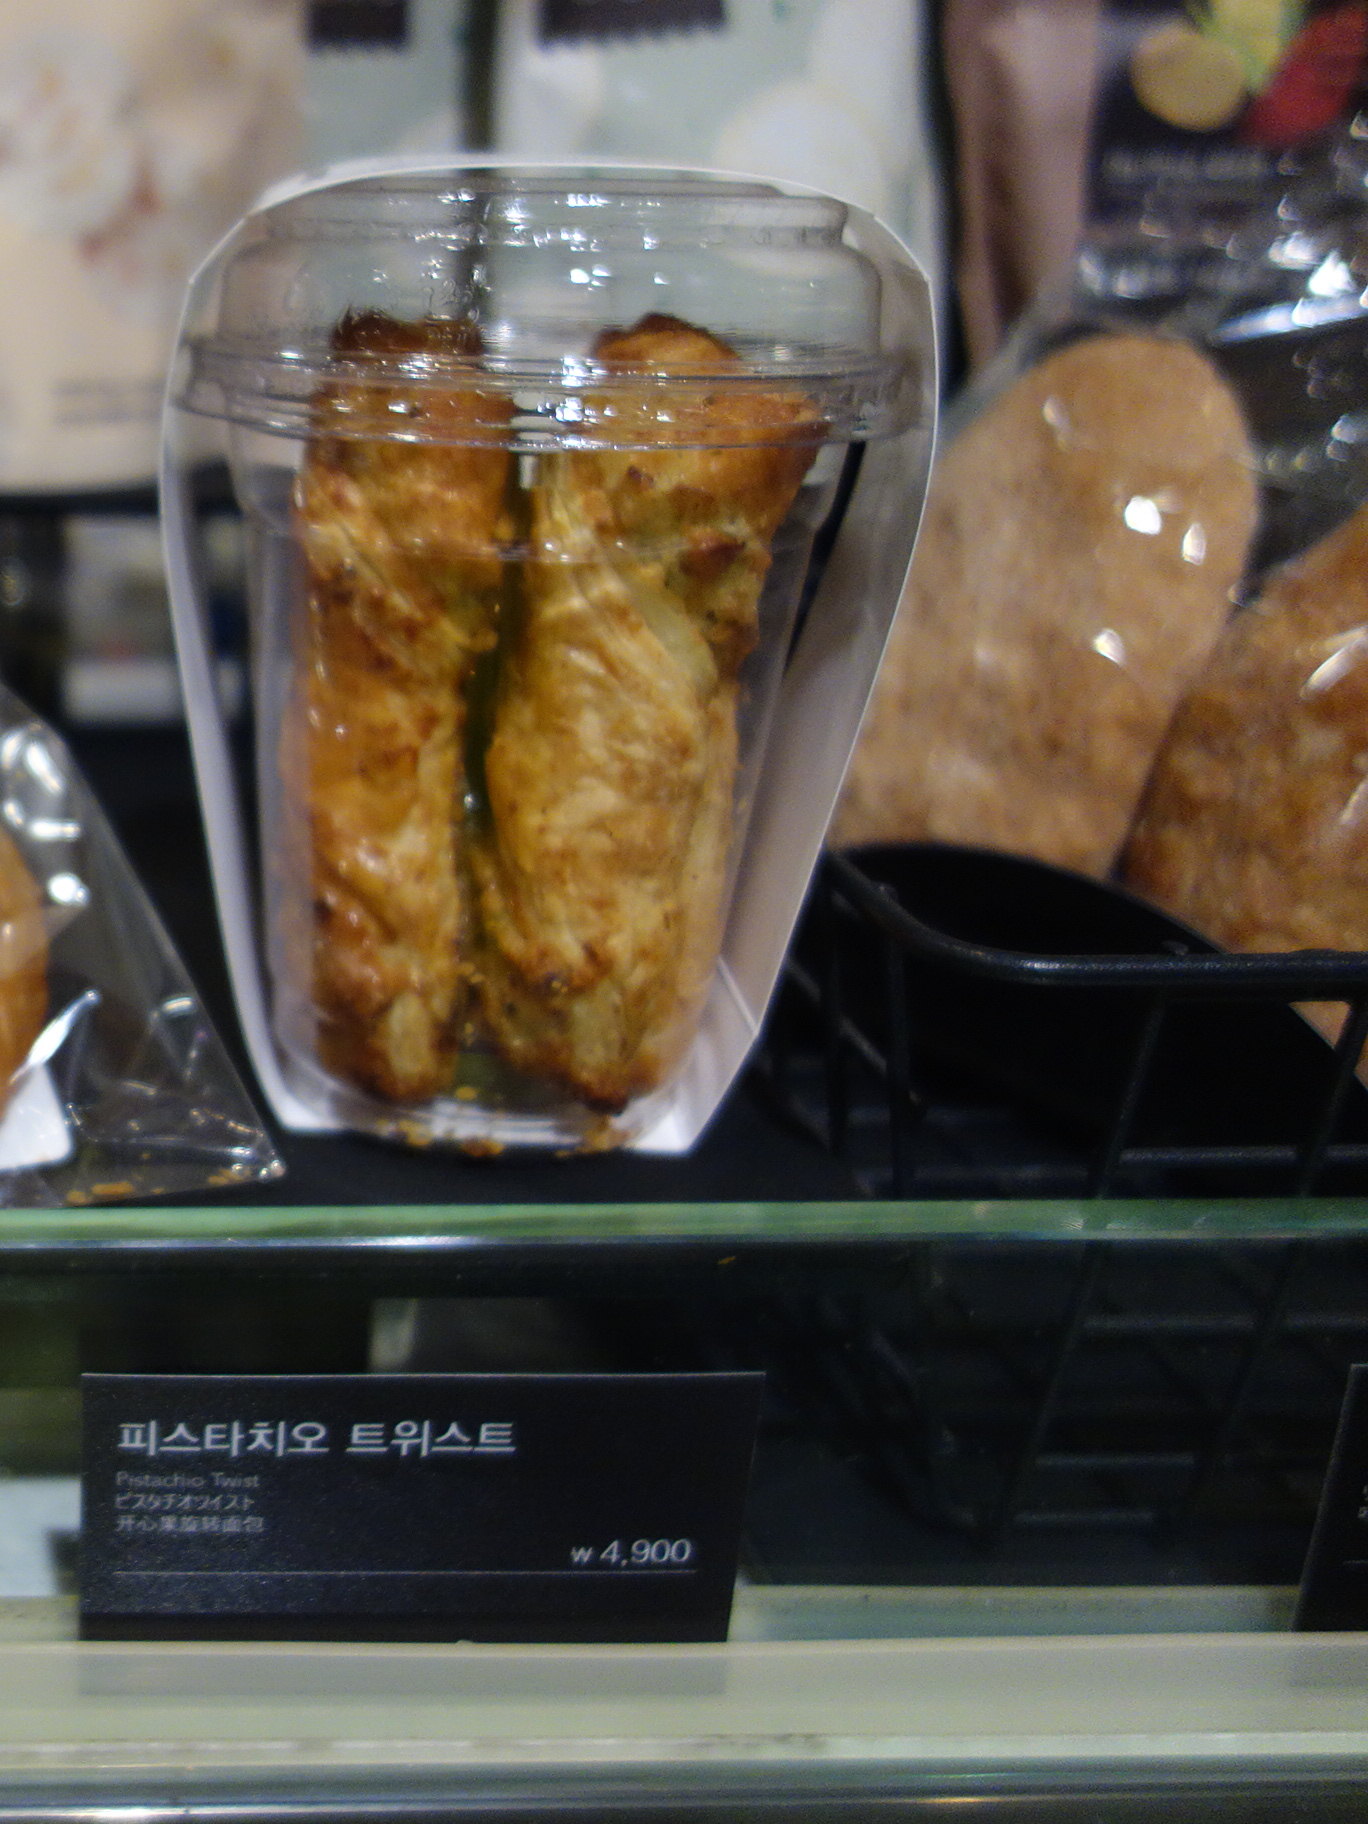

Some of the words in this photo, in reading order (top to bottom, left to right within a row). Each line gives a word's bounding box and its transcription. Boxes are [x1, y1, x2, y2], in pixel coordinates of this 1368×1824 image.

[117, 1419, 330, 1458] 피스타치오
[345, 1419, 517, 1458] 트위스트
[116, 1470, 205, 1487] Pistachio
[211, 1471, 259, 1488] Twist
